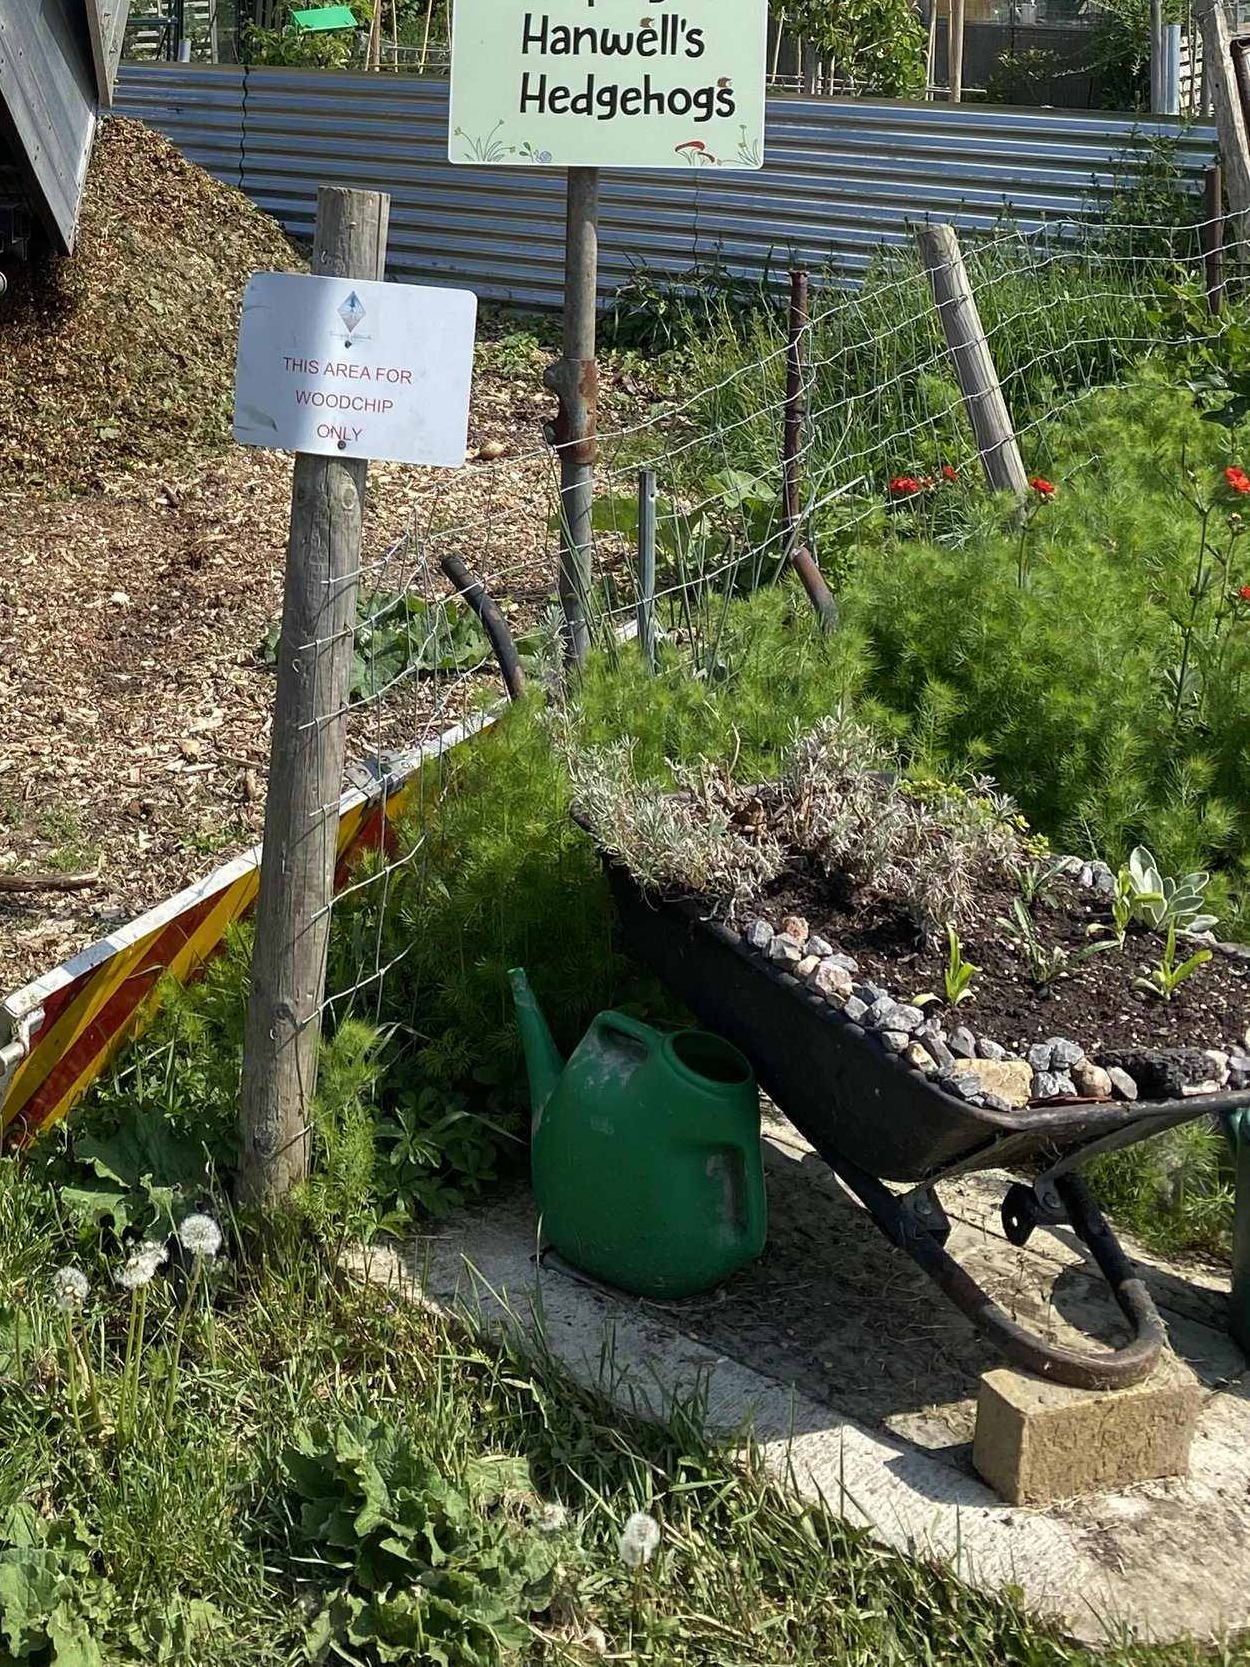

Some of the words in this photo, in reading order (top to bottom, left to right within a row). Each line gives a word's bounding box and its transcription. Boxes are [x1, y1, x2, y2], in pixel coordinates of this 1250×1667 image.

[521, 13, 705, 58] Hanwell's
[519, 72, 736, 122] Hedgehogs
[283, 357, 319, 374] THIS
[323, 362, 371, 380] AREA
[376, 367, 412, 384] FOR
[295, 390, 394, 413] WOODCHIP
[317, 424, 363, 441] ONLY
